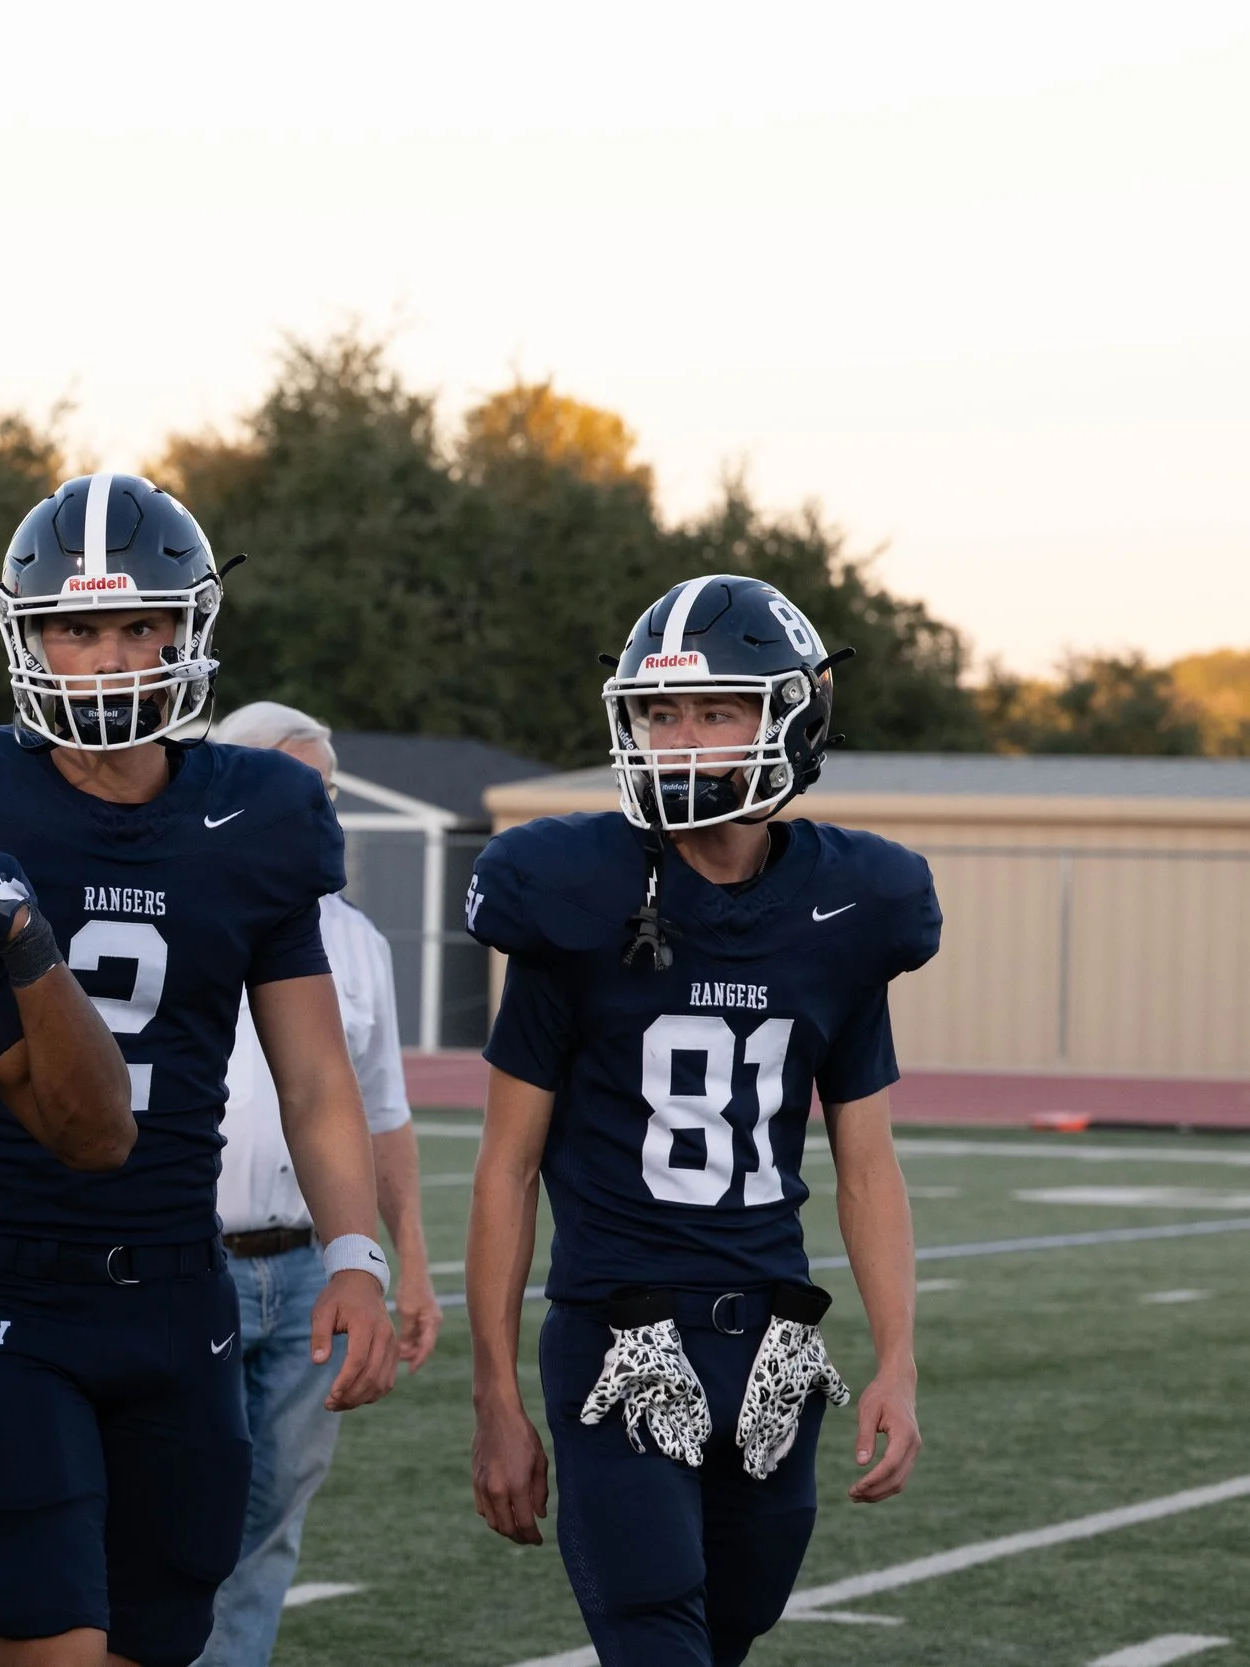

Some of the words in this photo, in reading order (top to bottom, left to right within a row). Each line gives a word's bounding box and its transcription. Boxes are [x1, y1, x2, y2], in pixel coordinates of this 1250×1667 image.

[69, 576, 127, 591] Riddell
[645, 654, 698, 669] Riddell
[83, 886, 167, 916] RANGERS
[689, 982, 768, 1009] RANGERS
[641, 1014, 795, 1207] 81
